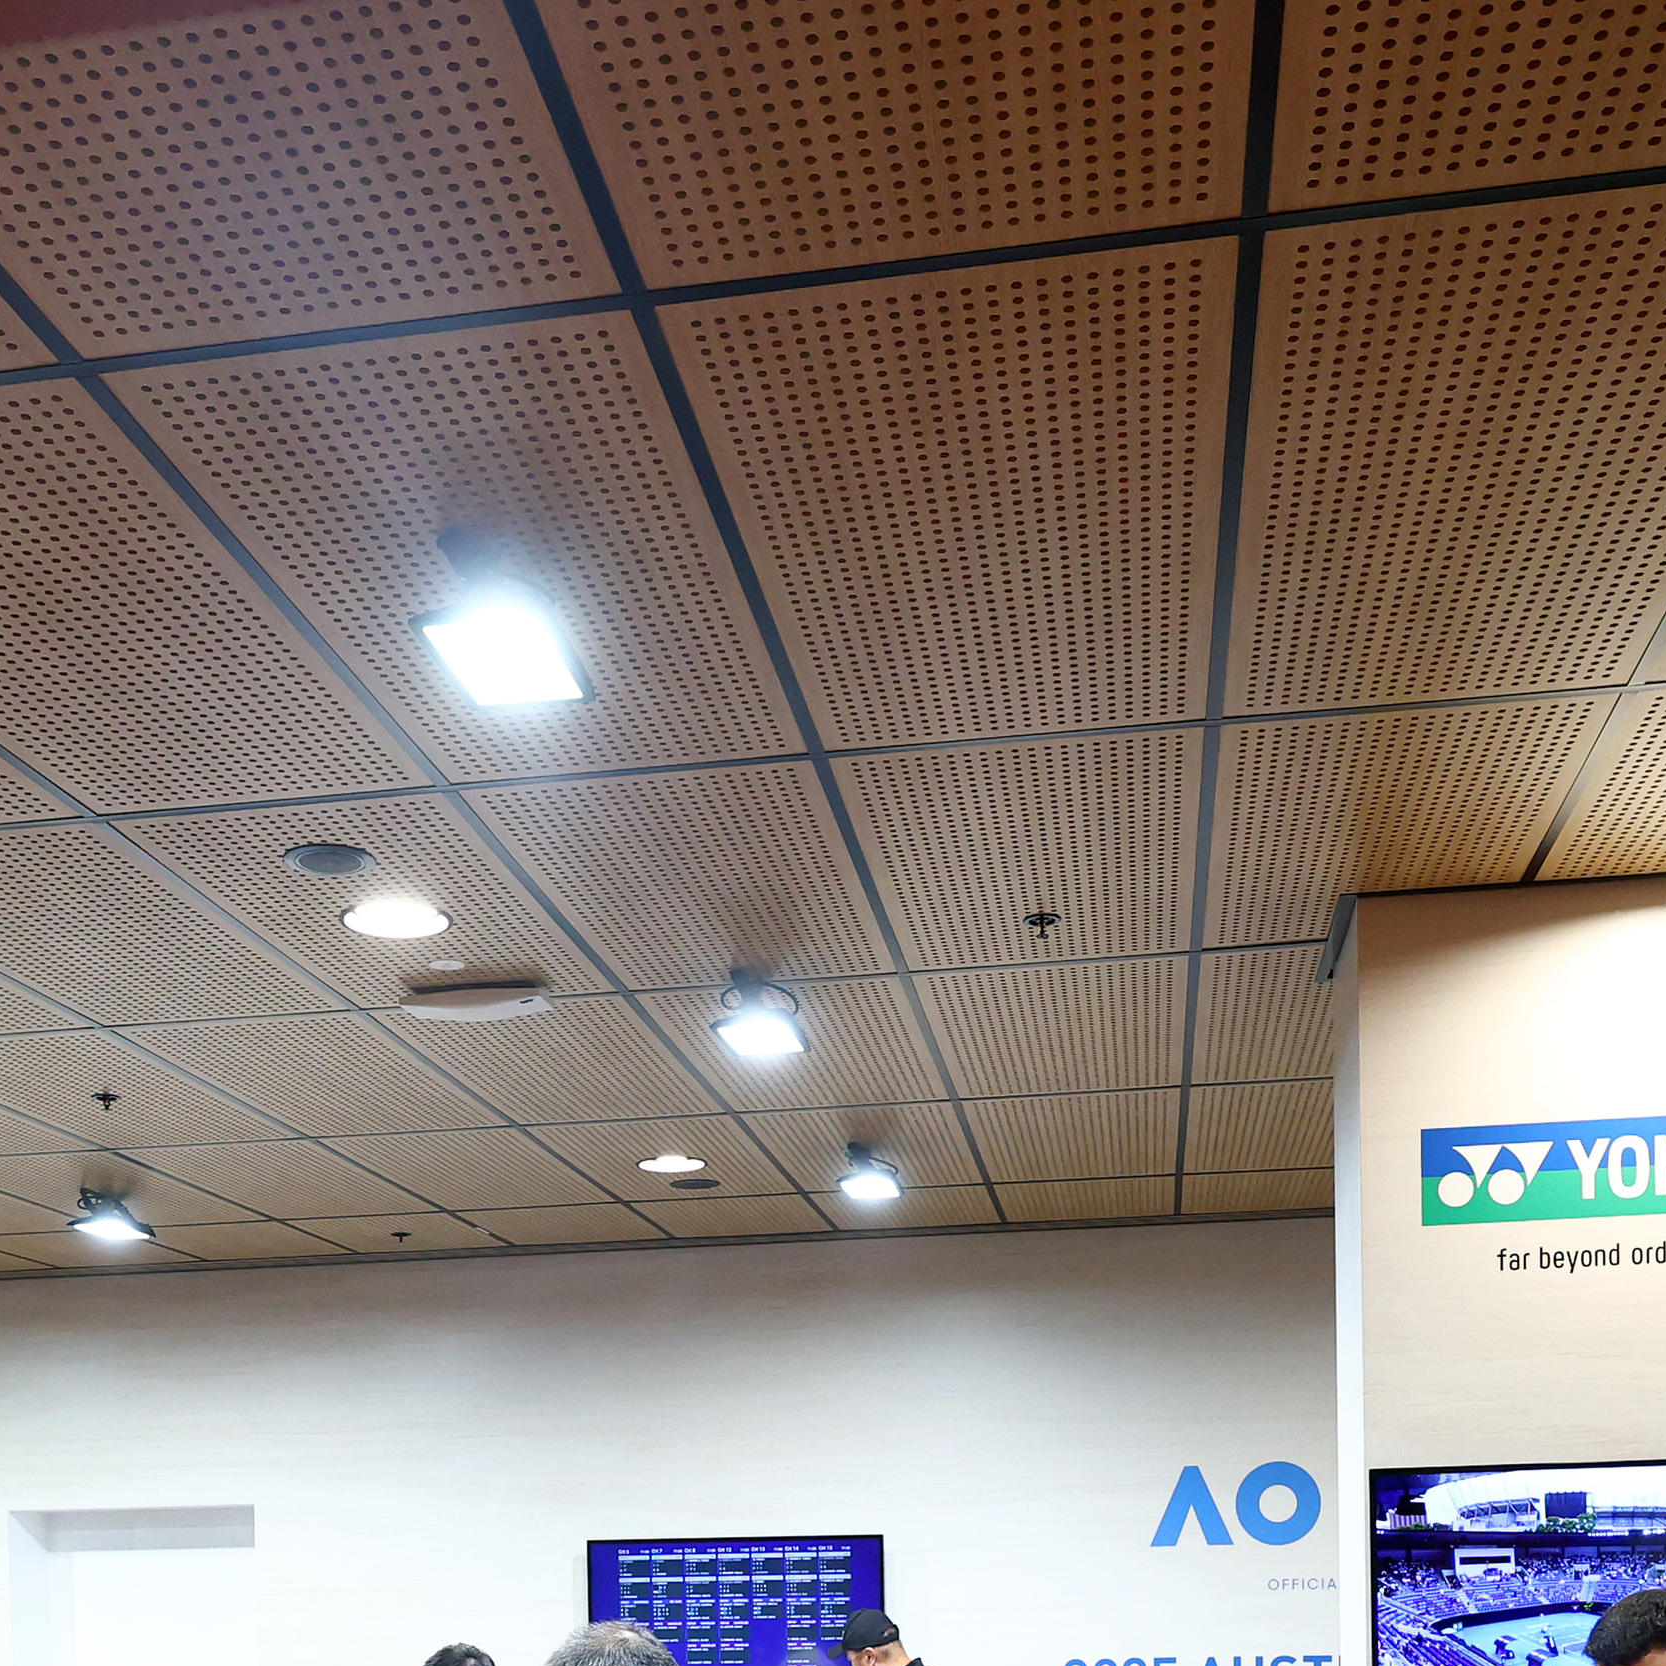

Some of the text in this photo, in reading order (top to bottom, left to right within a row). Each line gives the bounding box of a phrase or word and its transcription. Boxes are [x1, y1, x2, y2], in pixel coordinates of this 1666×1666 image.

[1496, 1247, 1530, 1272] far
[1539, 1243, 1621, 1274] beyond
[1150, 1460, 1322, 1547] AO
